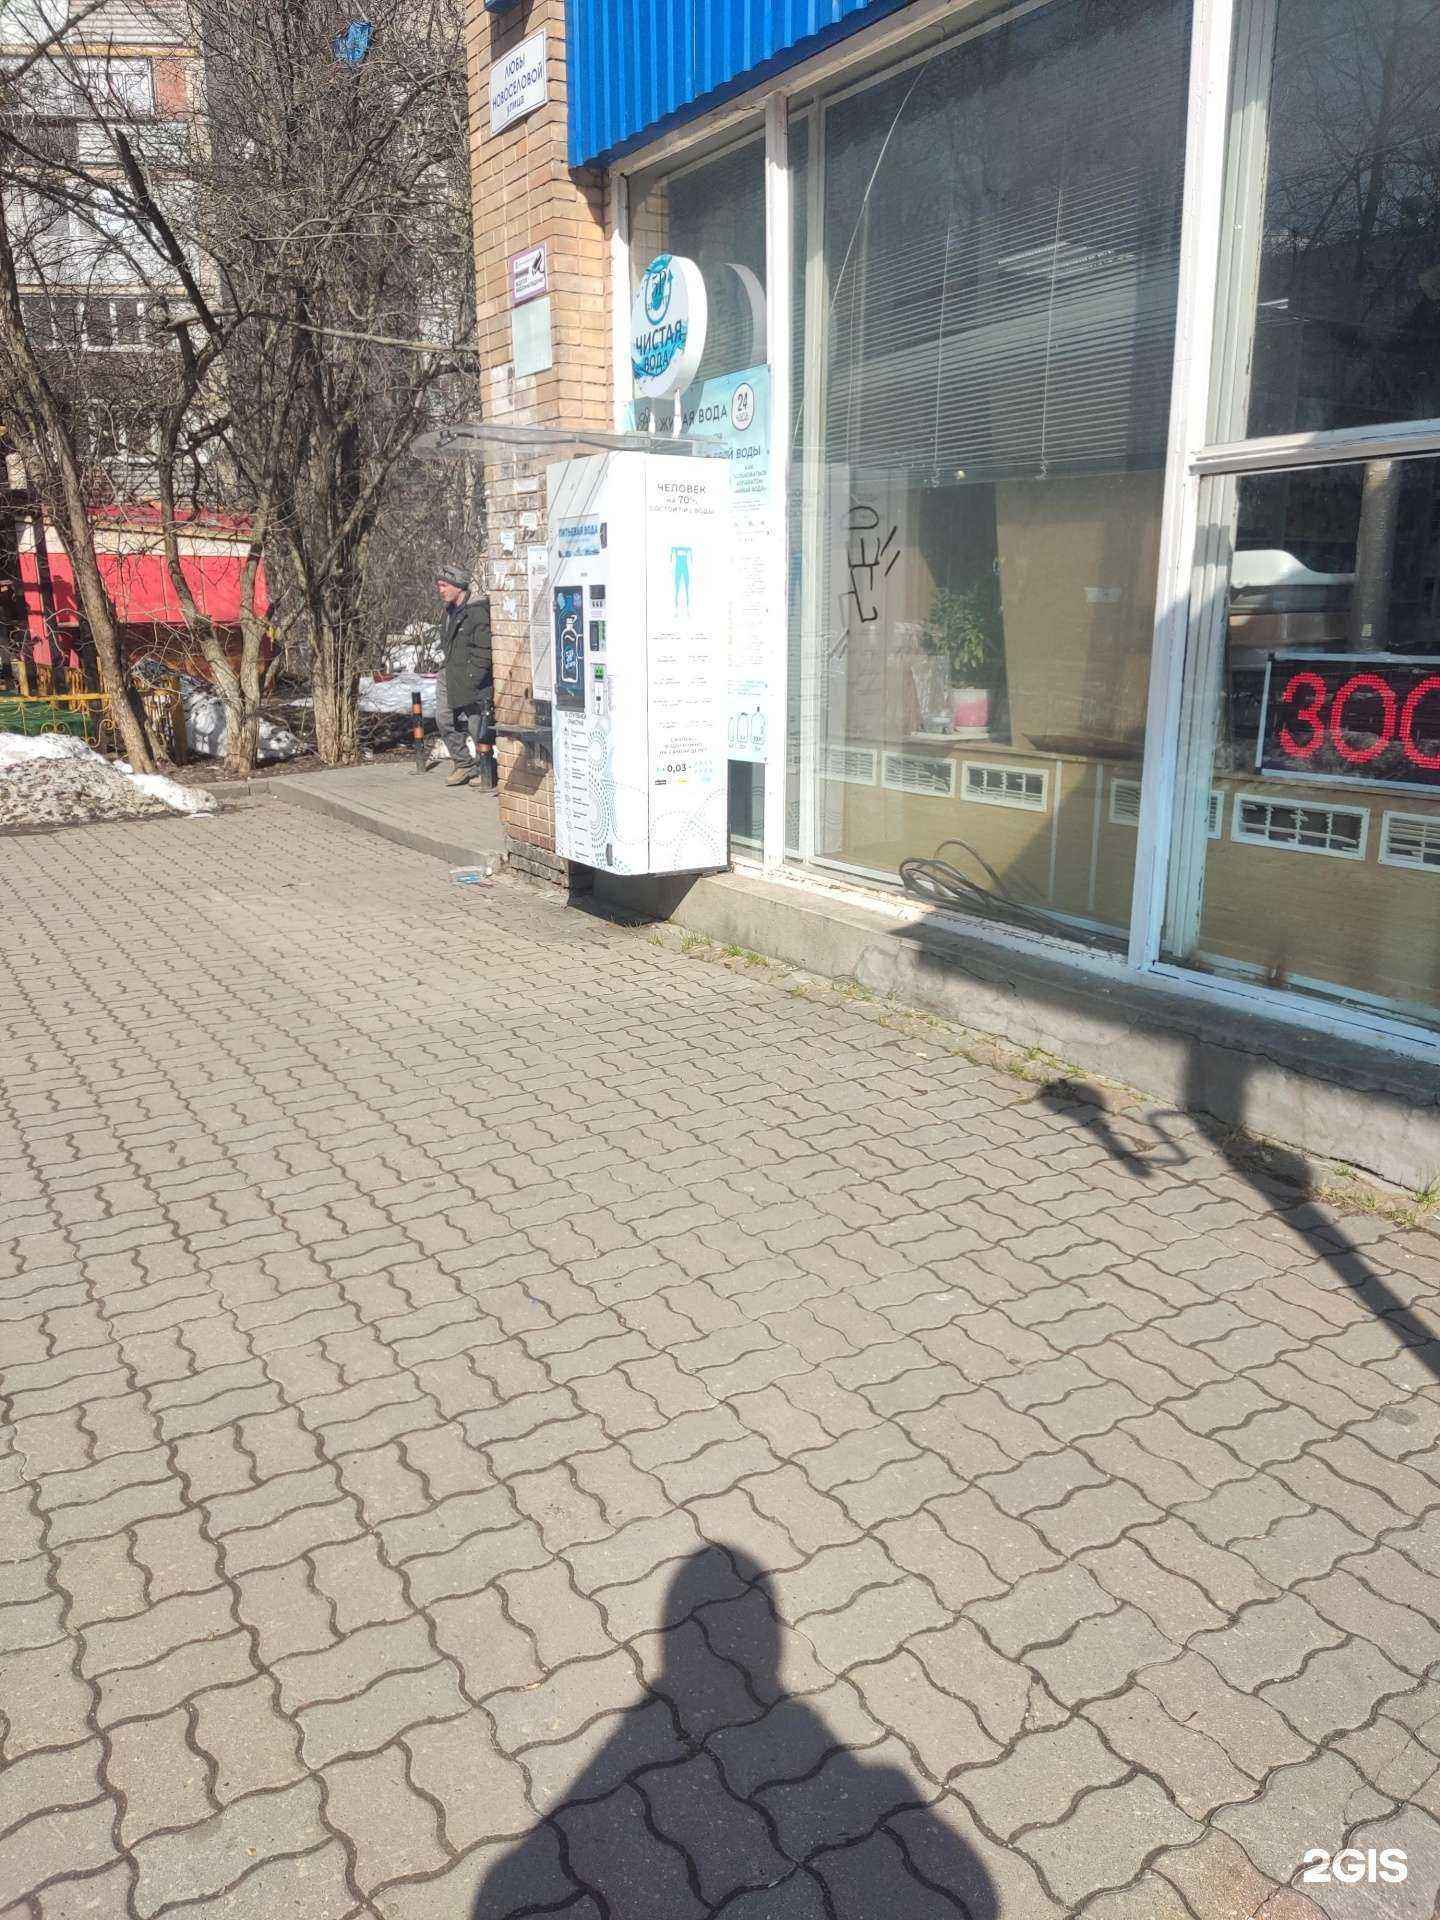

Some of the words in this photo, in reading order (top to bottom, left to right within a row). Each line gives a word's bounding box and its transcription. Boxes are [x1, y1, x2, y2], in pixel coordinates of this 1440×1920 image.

[505, 53, 526, 79] ЛЮБЫ
[506, 95, 525, 117] улица
[636, 320, 682, 354] ЧИСТАЯ
[644, 352, 670, 372] ВОДА
[737, 391, 748, 411] 24
[698, 404, 728, 424] ВОДА
[735, 445, 761, 459] ВОДЫ
[657, 483, 706, 494] ЧЕЛОВЕК
